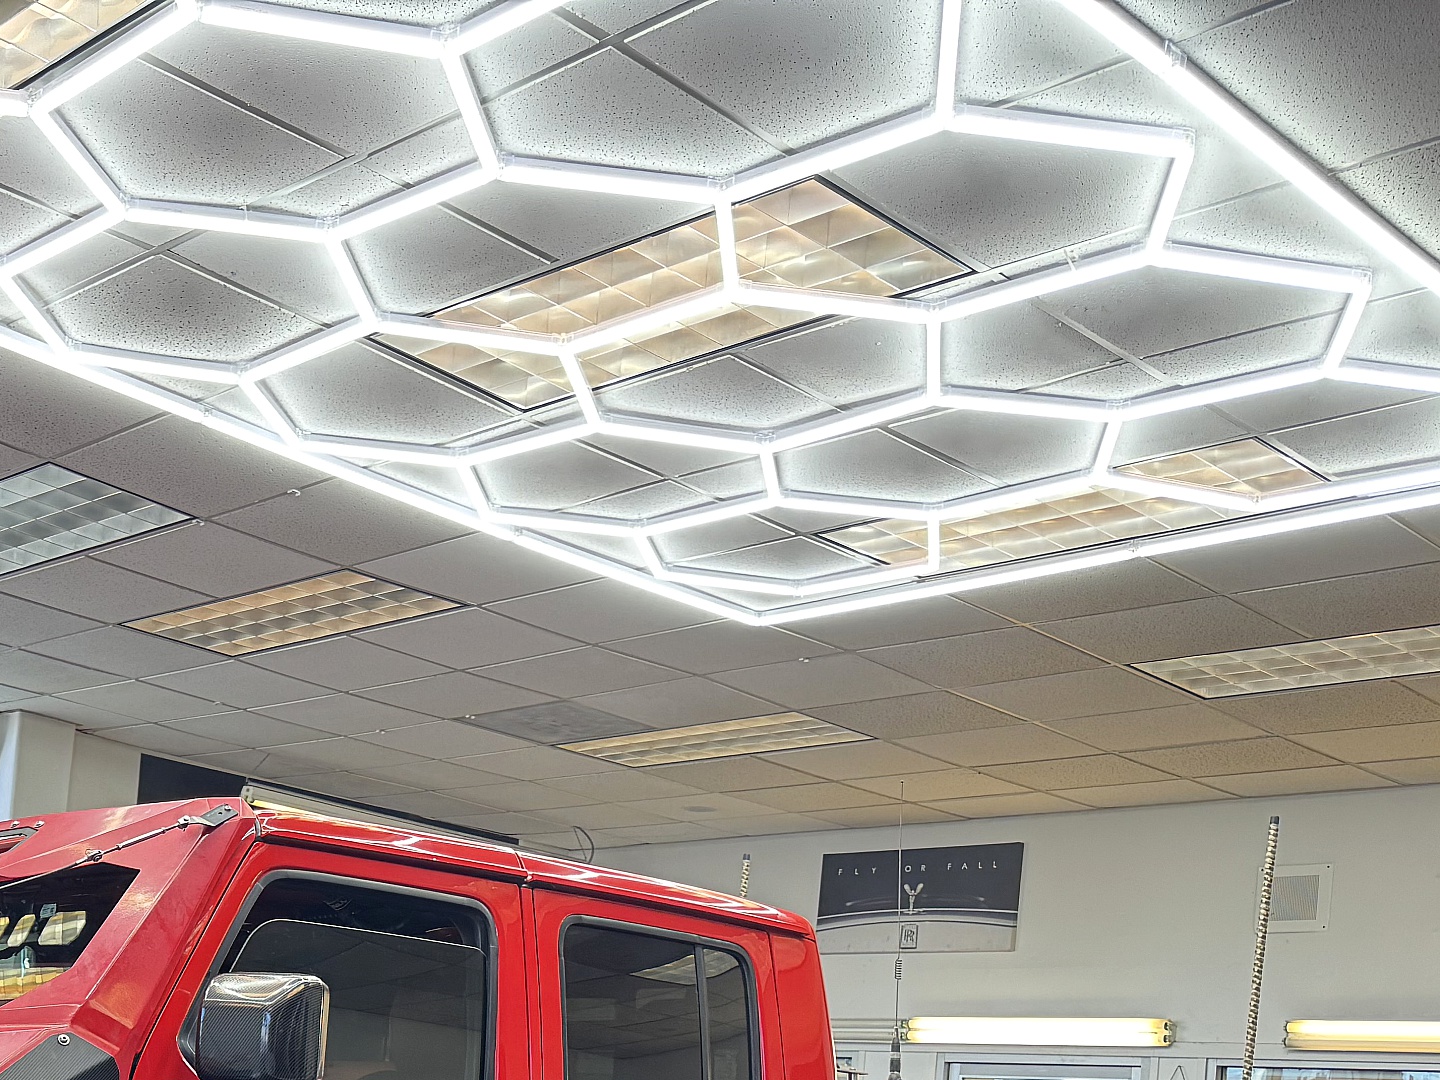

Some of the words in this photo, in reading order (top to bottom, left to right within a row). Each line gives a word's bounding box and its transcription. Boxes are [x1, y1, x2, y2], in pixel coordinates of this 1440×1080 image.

[837, 867, 877, 876] FLY
[904, 864, 926, 873] OR
[947, 860, 997, 871] FALL
